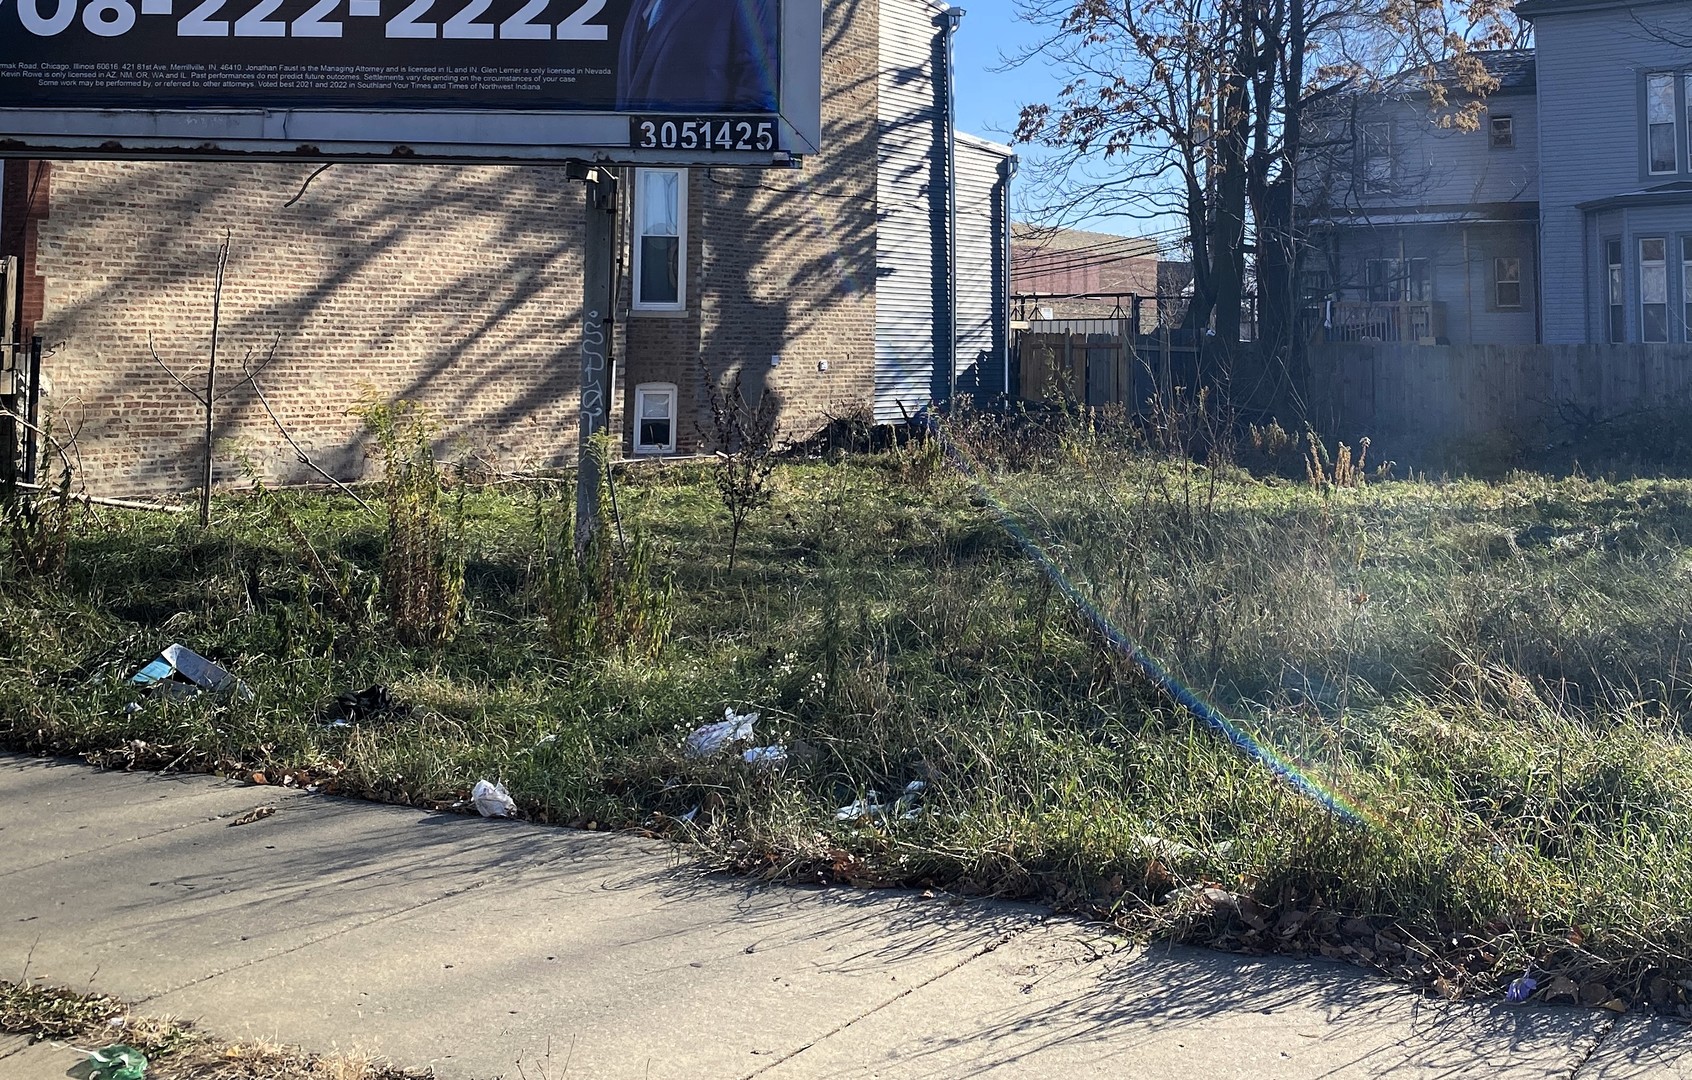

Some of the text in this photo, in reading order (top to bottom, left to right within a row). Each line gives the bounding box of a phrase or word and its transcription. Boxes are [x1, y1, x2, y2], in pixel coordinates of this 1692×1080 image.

[320, 65, 354, 74] Managing
[355, 66, 385, 74] Attorney
[530, 67, 546, 76] only
[51, 71, 66, 80] only
[208, 73, 255, 81] performances
[279, 73, 304, 82] predict
[422, 74, 458, 83] depending
[105, 80, 142, 88] performed
[640, 121, 773, 150] 3051425
